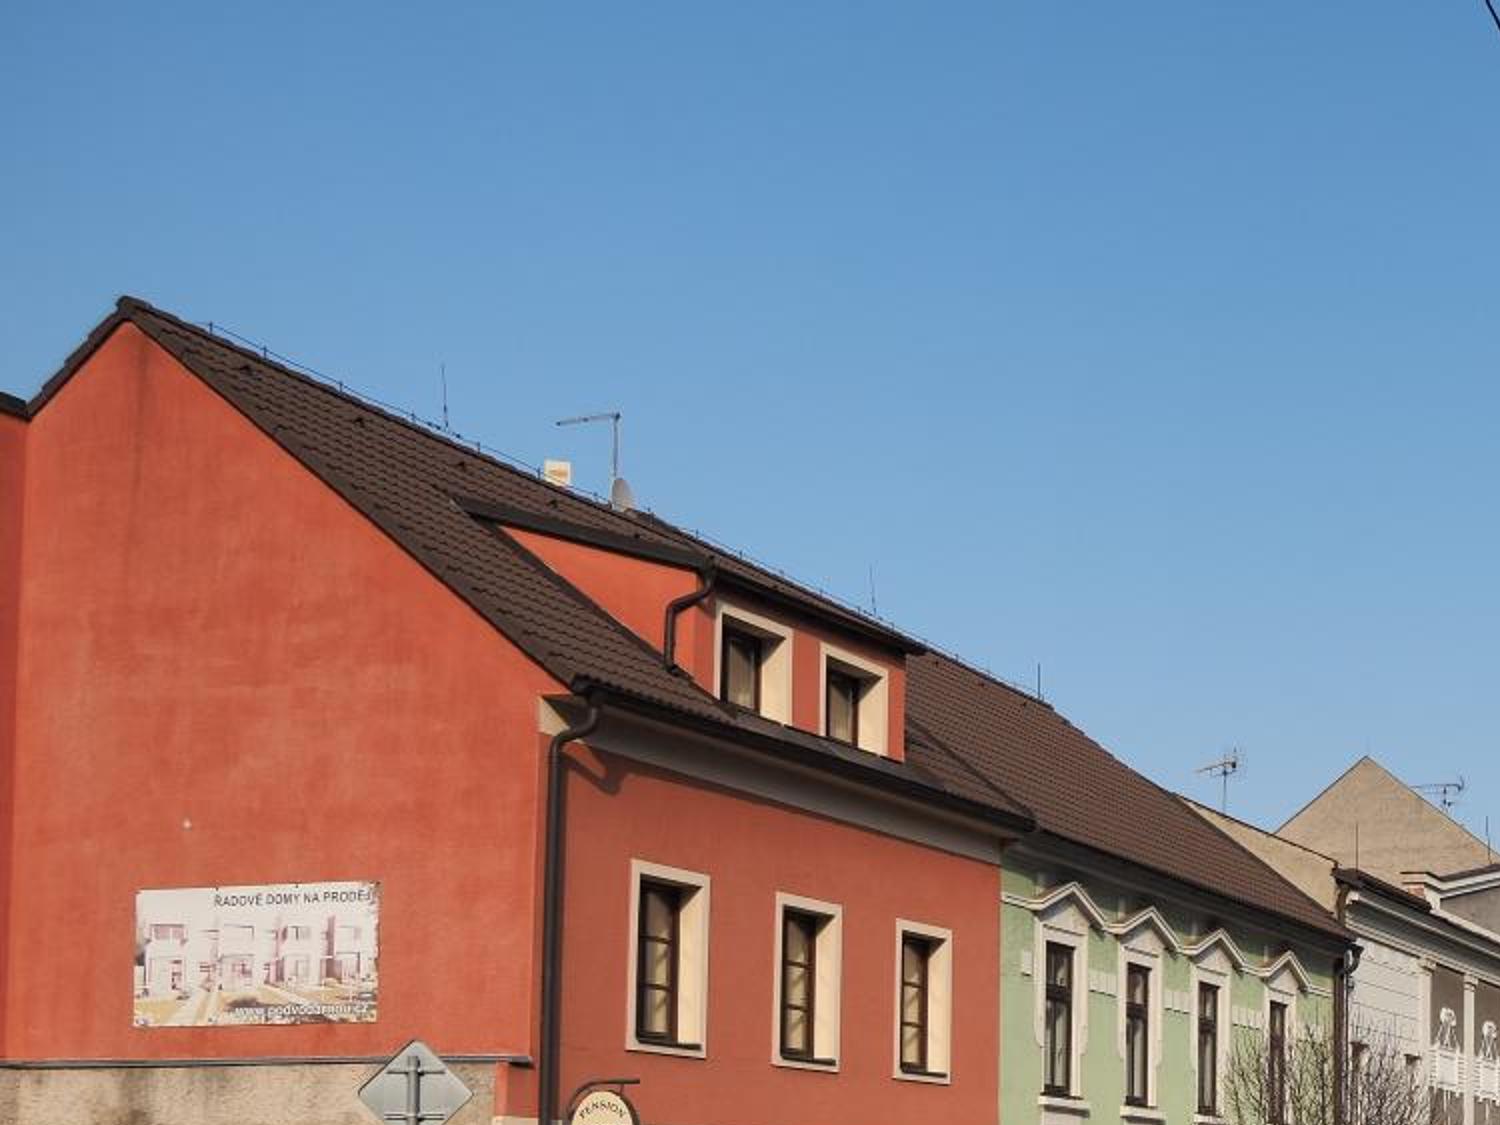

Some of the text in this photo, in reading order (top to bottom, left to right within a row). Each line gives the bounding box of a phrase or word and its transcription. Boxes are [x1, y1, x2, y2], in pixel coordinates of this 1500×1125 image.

[265, 893, 299, 905] DOMY
[304, 892, 320, 903] NA
[579, 1101, 625, 1118] PENSION
